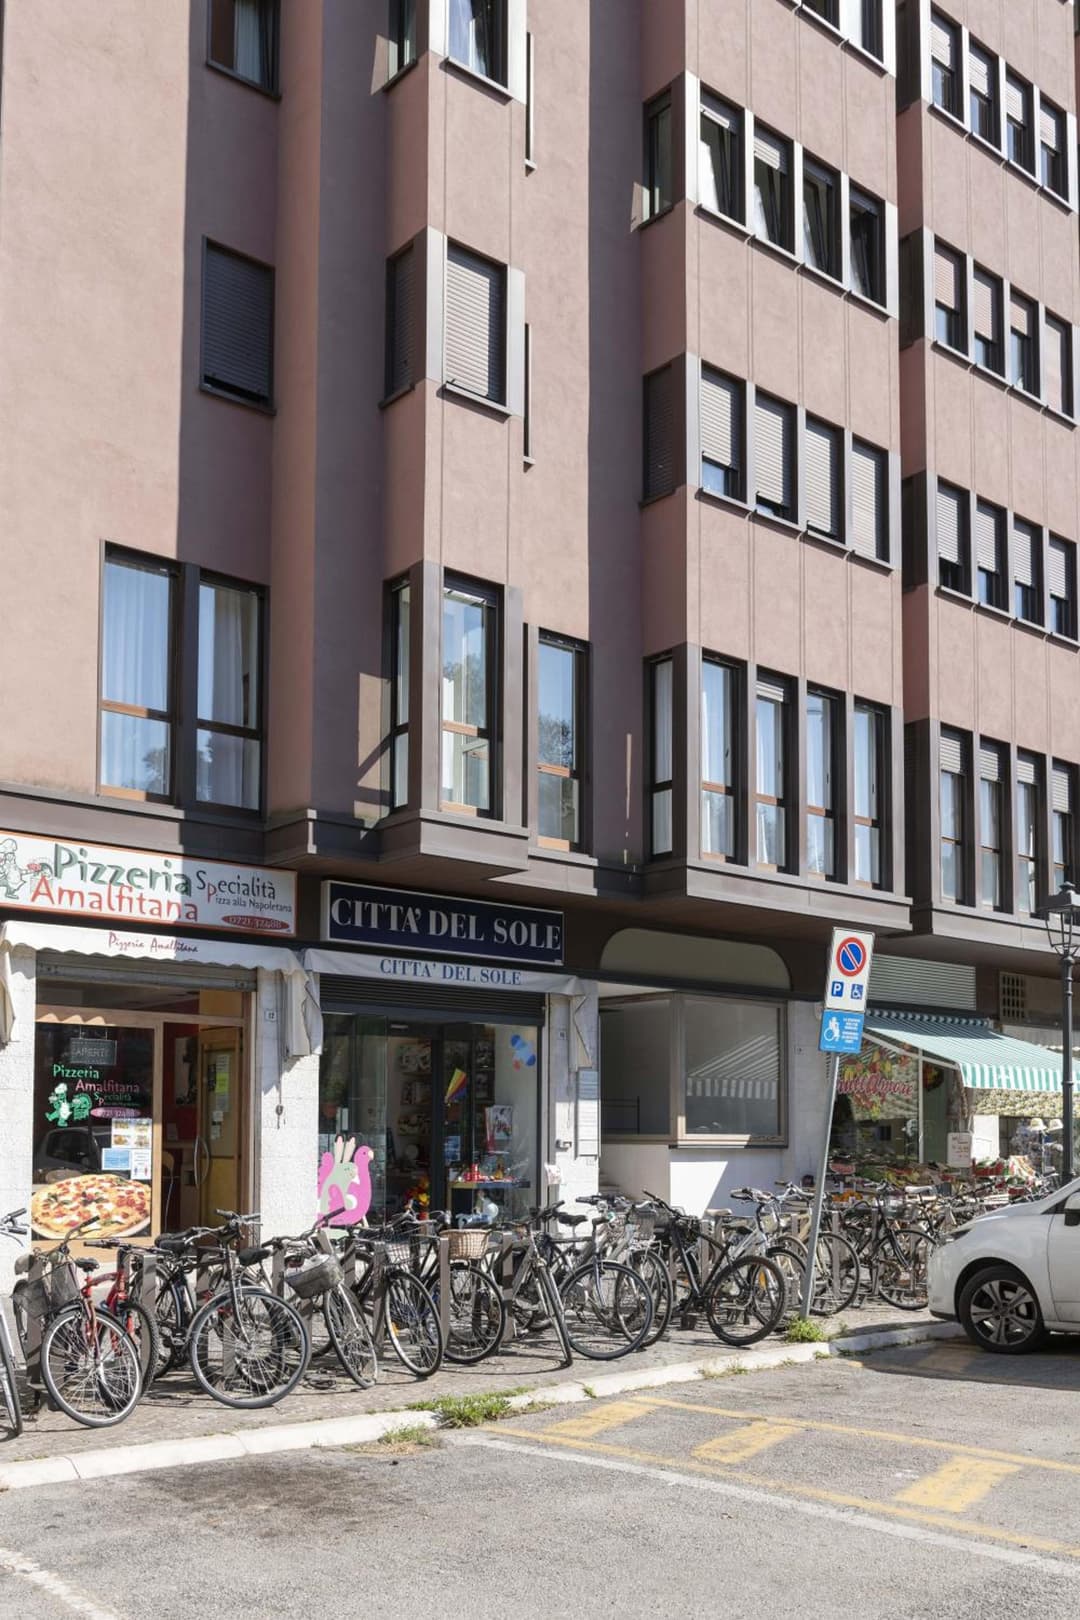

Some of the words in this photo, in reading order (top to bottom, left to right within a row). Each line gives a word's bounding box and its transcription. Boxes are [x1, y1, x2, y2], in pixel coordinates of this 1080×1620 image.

[54, 843, 192, 897] Pizzeria
[31, 875, 198, 922] Amalfitana
[196, 870, 276, 902] Specialità
[249, 898, 292, 912] Napoletana
[108, 931, 145, 951] Pizzeria
[150, 937, 199, 953] Amalfitana
[428, 910, 484, 941] DEL
[493, 919, 561, 950] SOLE
[380, 959, 436, 978] CITTA'
[442, 965, 476, 982] DEL
[480, 968, 521, 985] SOLE
[53, 1063, 100, 1079] Pizzeria
[75, 1079, 140, 1093] Amalfitana
